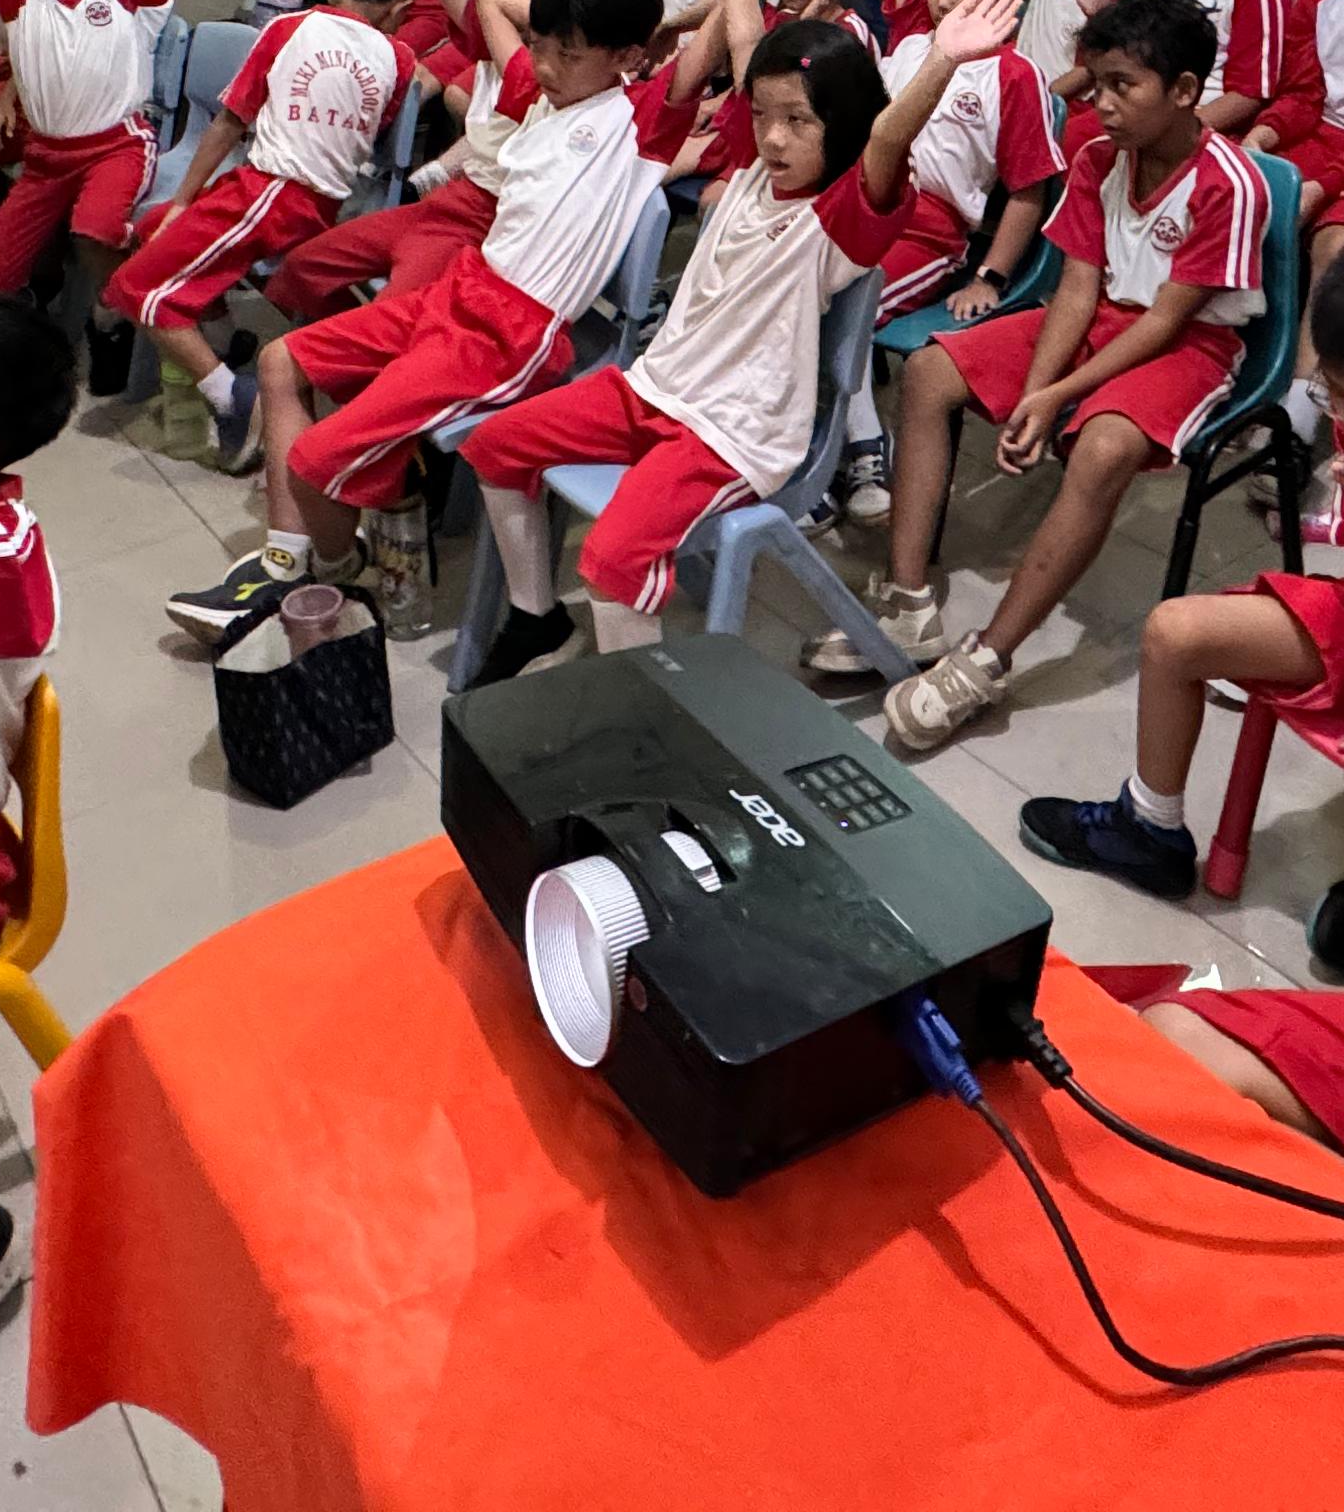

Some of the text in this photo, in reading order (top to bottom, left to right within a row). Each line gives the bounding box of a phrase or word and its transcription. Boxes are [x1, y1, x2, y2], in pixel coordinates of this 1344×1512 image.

[290, 60, 318, 98] MIKI
[314, 50, 351, 70] MINI
[729, 789, 806, 848] acer
